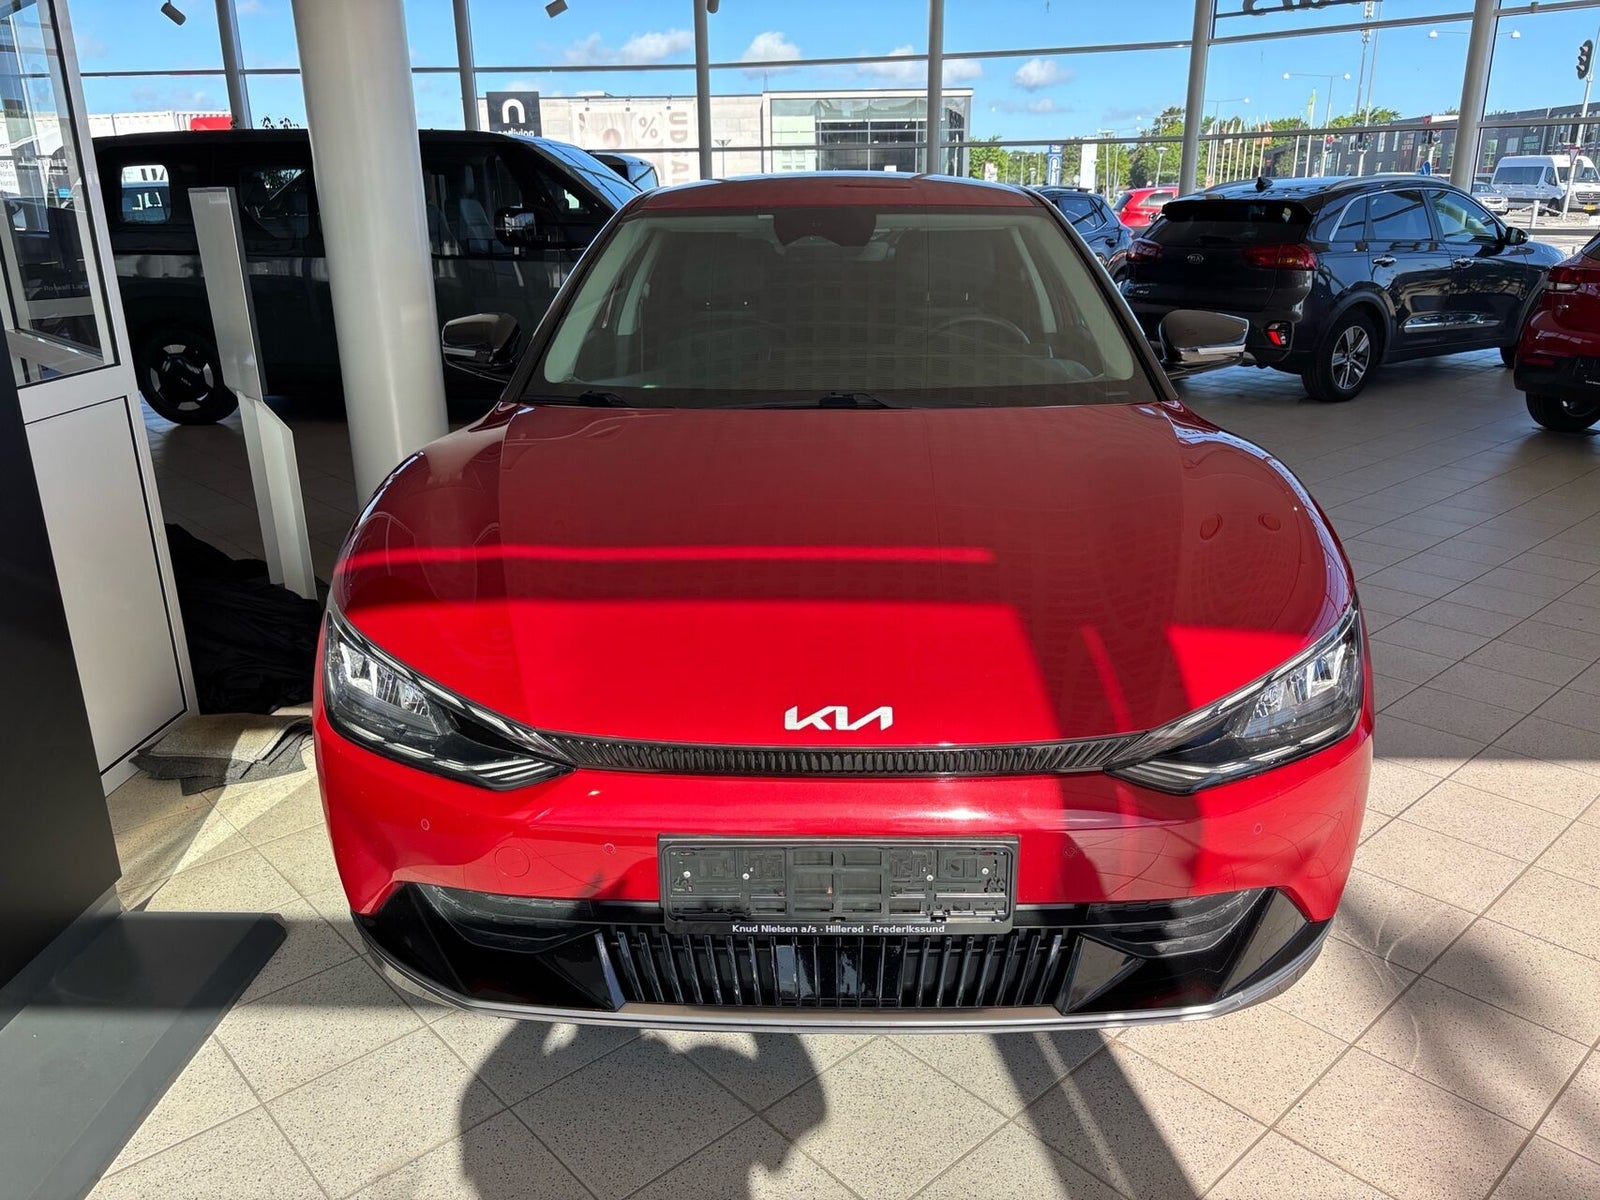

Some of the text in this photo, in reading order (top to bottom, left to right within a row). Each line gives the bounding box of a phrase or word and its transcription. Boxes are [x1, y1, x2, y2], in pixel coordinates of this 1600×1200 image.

[669, 111, 690, 185] UDA
[784, 705, 893, 731] KIA
[732, 924, 945, 933] Knud Nielsen a/s Hillerød Frederikssund
